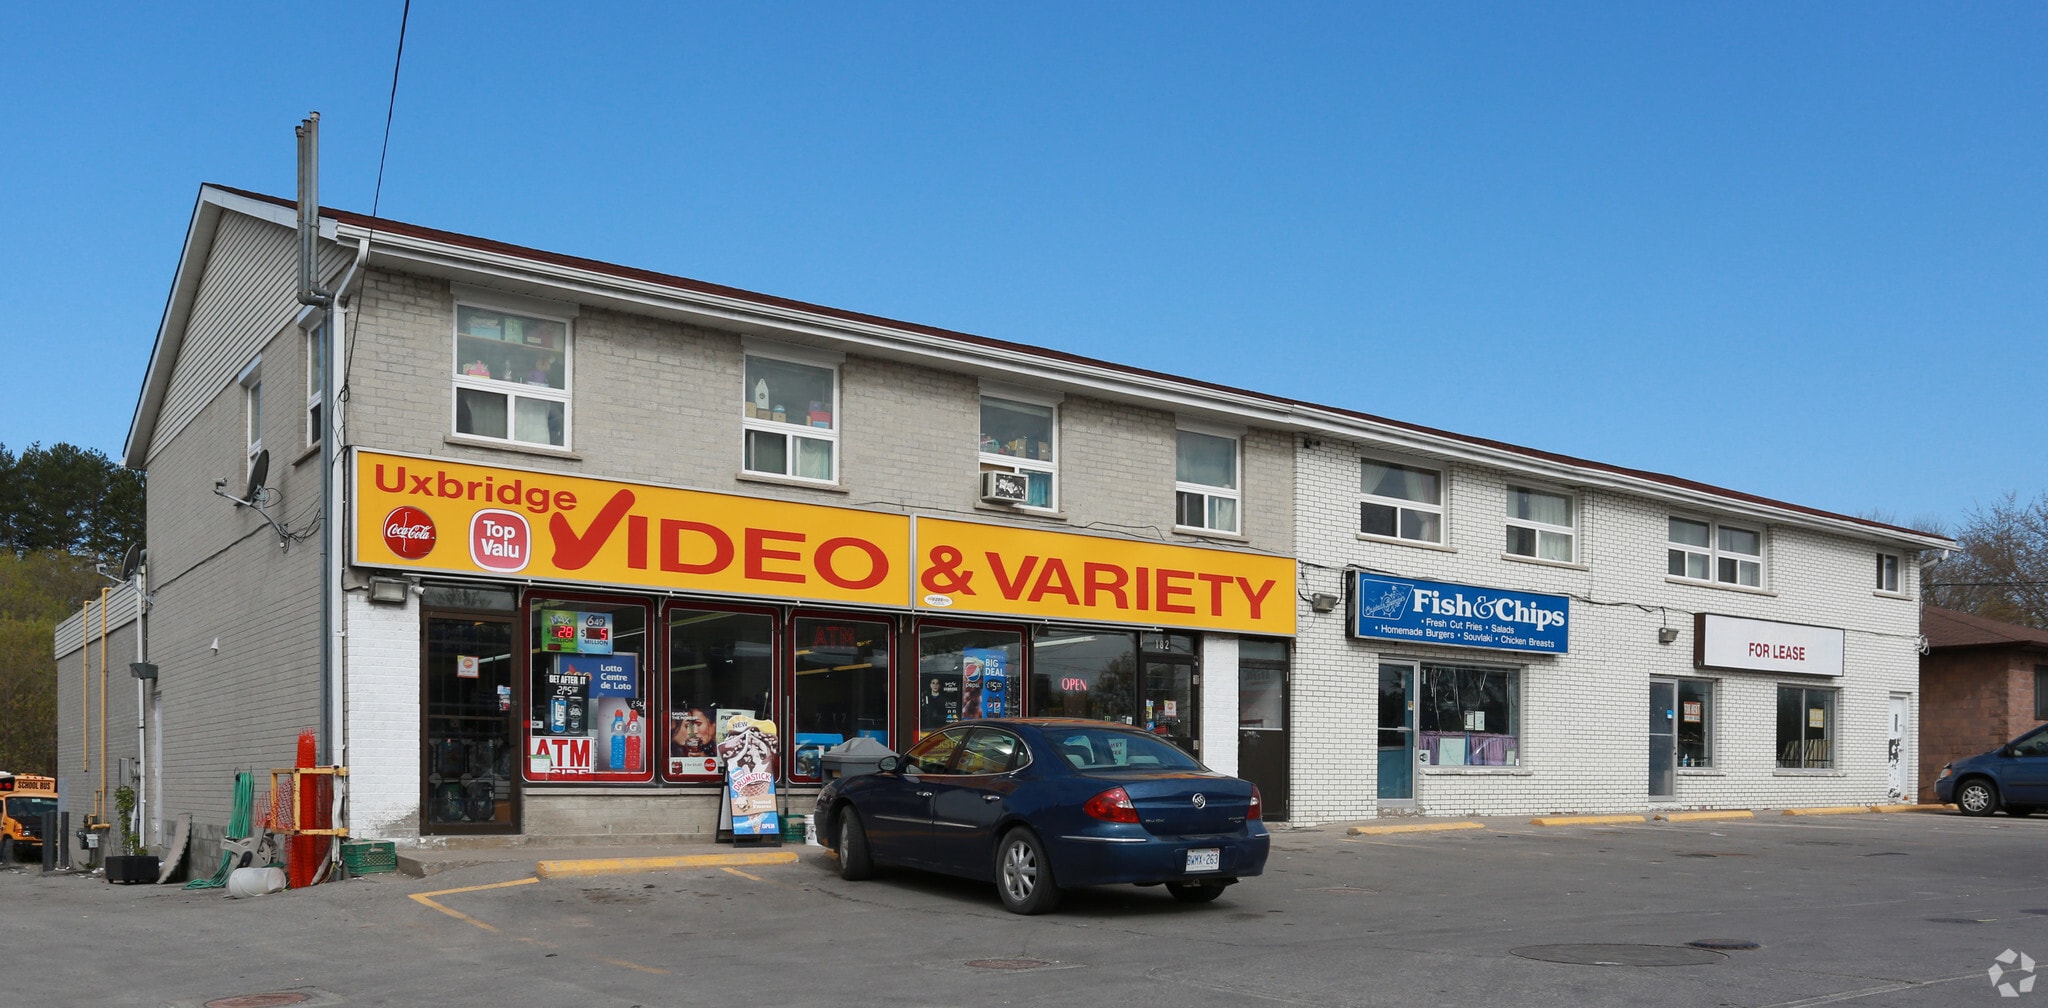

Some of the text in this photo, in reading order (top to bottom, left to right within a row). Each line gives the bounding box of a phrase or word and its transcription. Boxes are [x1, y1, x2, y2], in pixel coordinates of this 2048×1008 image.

[375, 463, 577, 514] Uxbridge
[483, 519, 516, 541] Top
[481, 538, 520, 559] Valu
[548, 488, 1276, 620] VIDEO & VARIETY
[558, 625, 574, 638] 28
[1426, 617, 1515, 634] Fresh Cut Fries Salads
[600, 628, 607, 640] 5
[813, 625, 855, 649] ATM
[1381, 624, 1555, 648] Homemade Burgers Souvlaki Chicken Breasts
[1155, 639, 1170, 650] 182
[1749, 642, 1806, 661] FOR LEASE
[601, 664, 623, 673] Lotto
[985, 659, 999, 668] BIG
[600, 673, 628, 682] Centre
[985, 667, 1005, 677] DEAL
[549, 675, 587, 685] GET AFTER IT
[600, 682, 632, 690] de Loto
[1061, 677, 1087, 691] OPEN
[614, 722, 623, 731] G
[629, 722, 637, 731] G
[732, 721, 748, 729] NEW
[536, 738, 590, 767] ATM
[18, 781, 51, 790] SCHOOL BUS
[733, 773, 771, 791] DRUMSTICK
